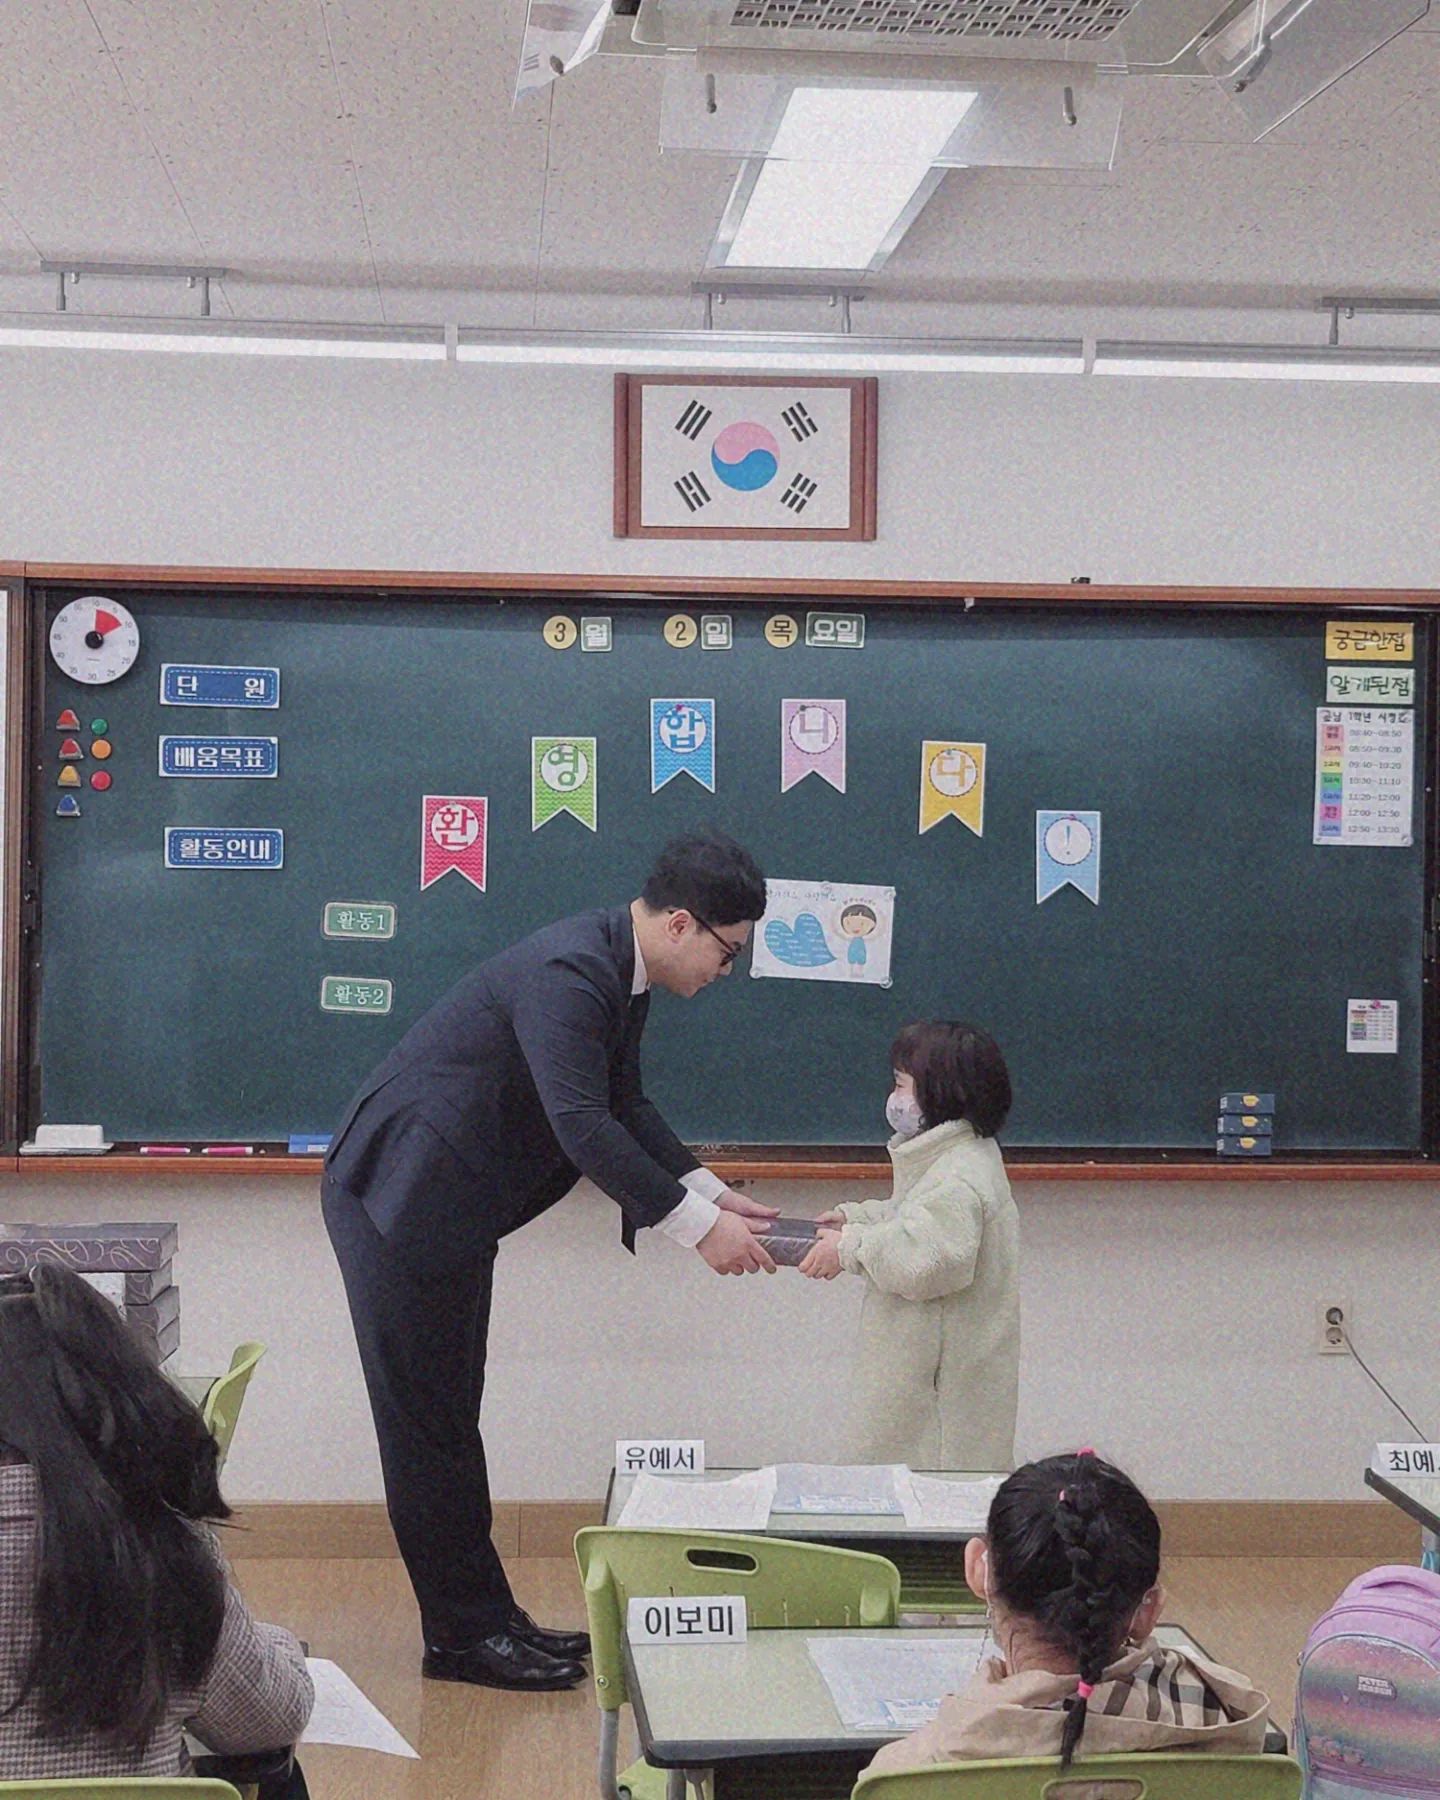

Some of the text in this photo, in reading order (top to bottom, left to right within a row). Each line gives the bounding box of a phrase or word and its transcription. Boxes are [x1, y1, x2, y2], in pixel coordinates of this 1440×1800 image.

[1332, 628, 1406, 652] 궁금한점
[1330, 675, 1410, 697] 알게된점
[174, 746, 265, 769] 배움목표
[436, 806, 475, 847] 환
[547, 747, 580, 787] 영
[665, 709, 701, 749] 합
[799, 709, 829, 745] 니
[936, 755, 974, 788] 다
[179, 837, 271, 861] 활동안내
[336, 910, 386, 931] 활동1
[333, 984, 384, 1005] 활동2
[624, 1446, 695, 1471] 유예서
[1388, 1449, 1440, 1473] 최예
[644, 1605, 733, 1637] 이보미
